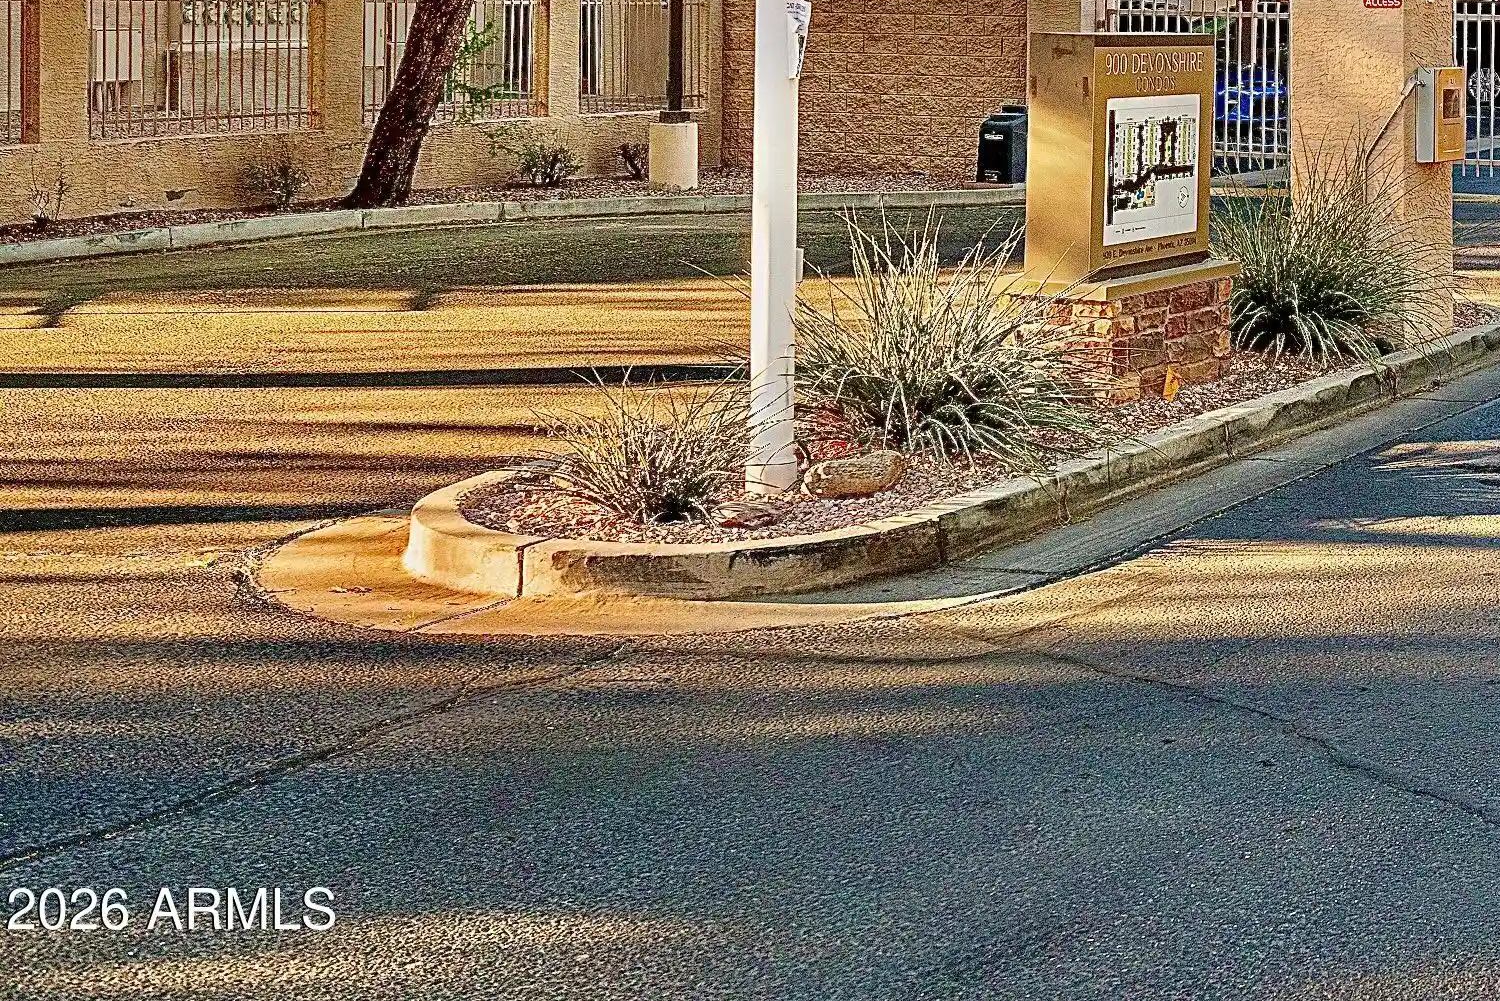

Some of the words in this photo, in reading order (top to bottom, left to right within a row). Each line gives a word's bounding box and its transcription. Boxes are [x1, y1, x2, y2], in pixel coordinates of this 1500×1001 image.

[1105, 53, 1128, 76] 900
[1131, 51, 1205, 74] DEVONSHIRE
[1135, 75, 1176, 93] CONDOS
